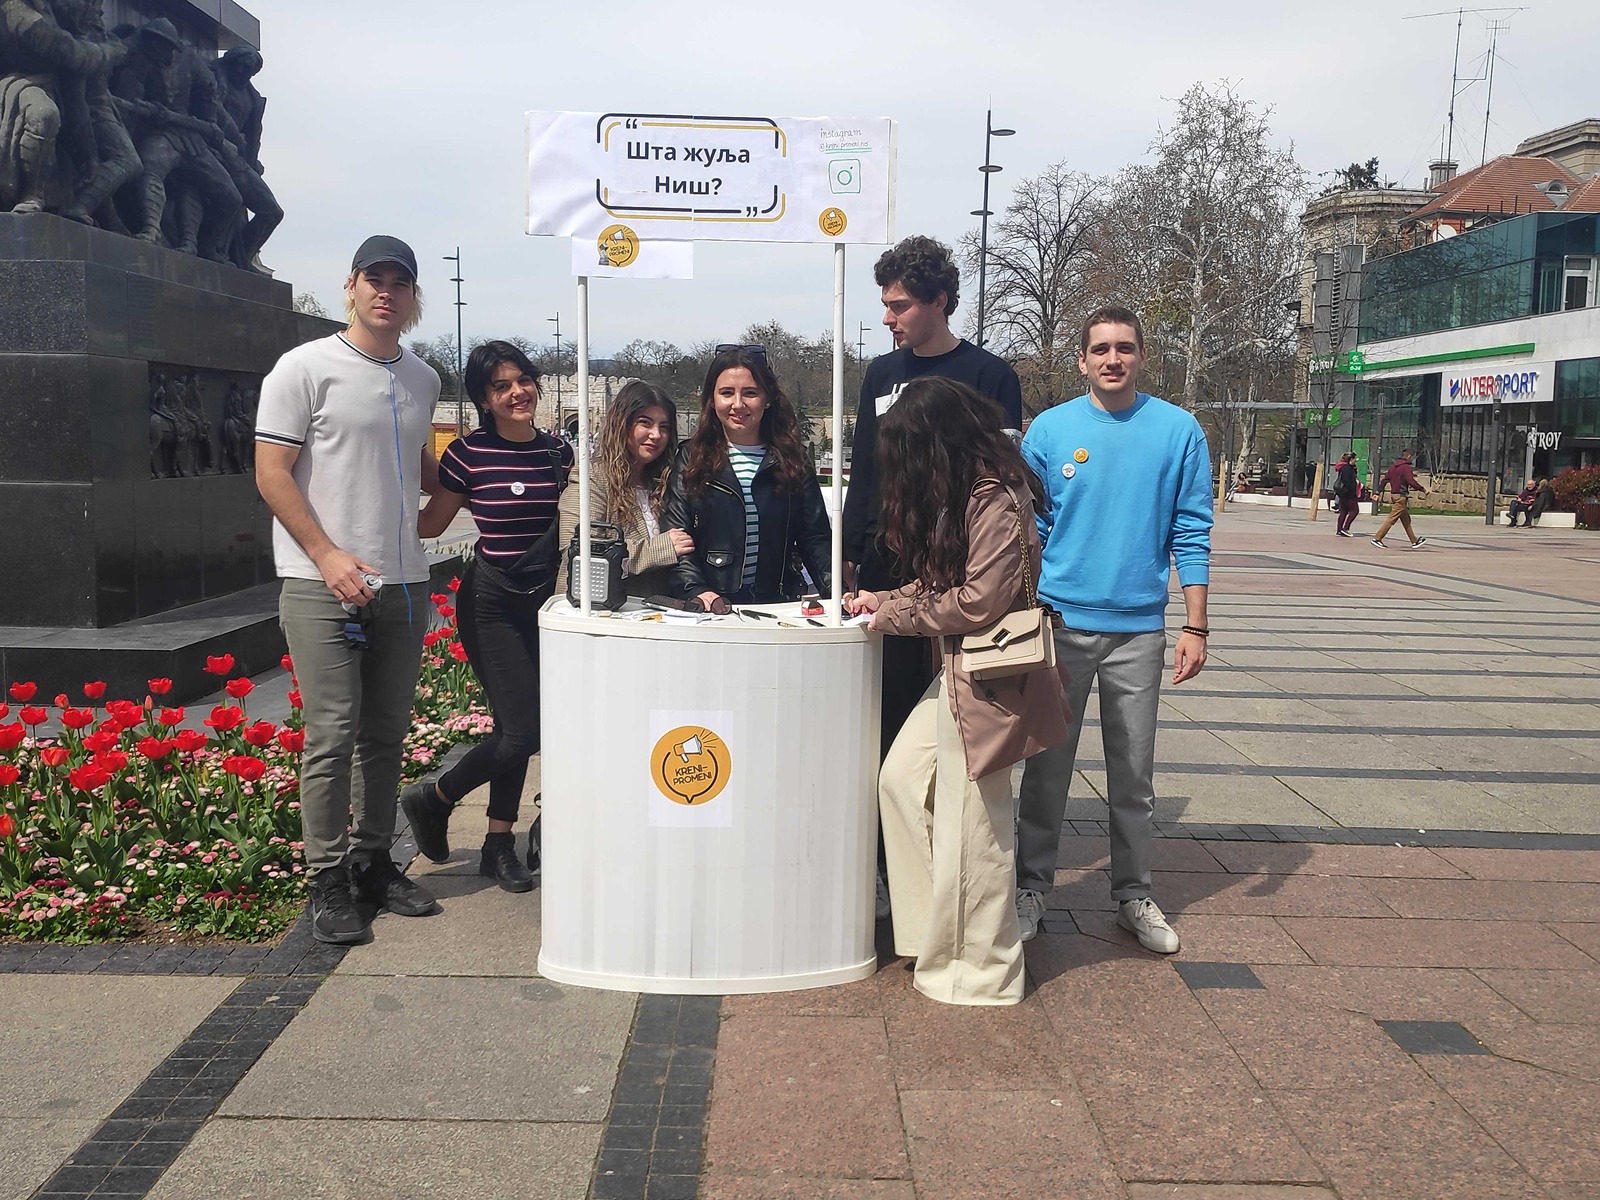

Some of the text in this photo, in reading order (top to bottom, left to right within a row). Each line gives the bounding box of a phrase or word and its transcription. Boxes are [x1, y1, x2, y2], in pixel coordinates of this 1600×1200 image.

[820, 128, 862, 142] instagram
[627, 141, 750, 167] Шта жуља
[655, 175, 723, 195] Ниш?
[674, 764, 708, 776] KRENI-
[673, 771, 712, 785] PROMENI
